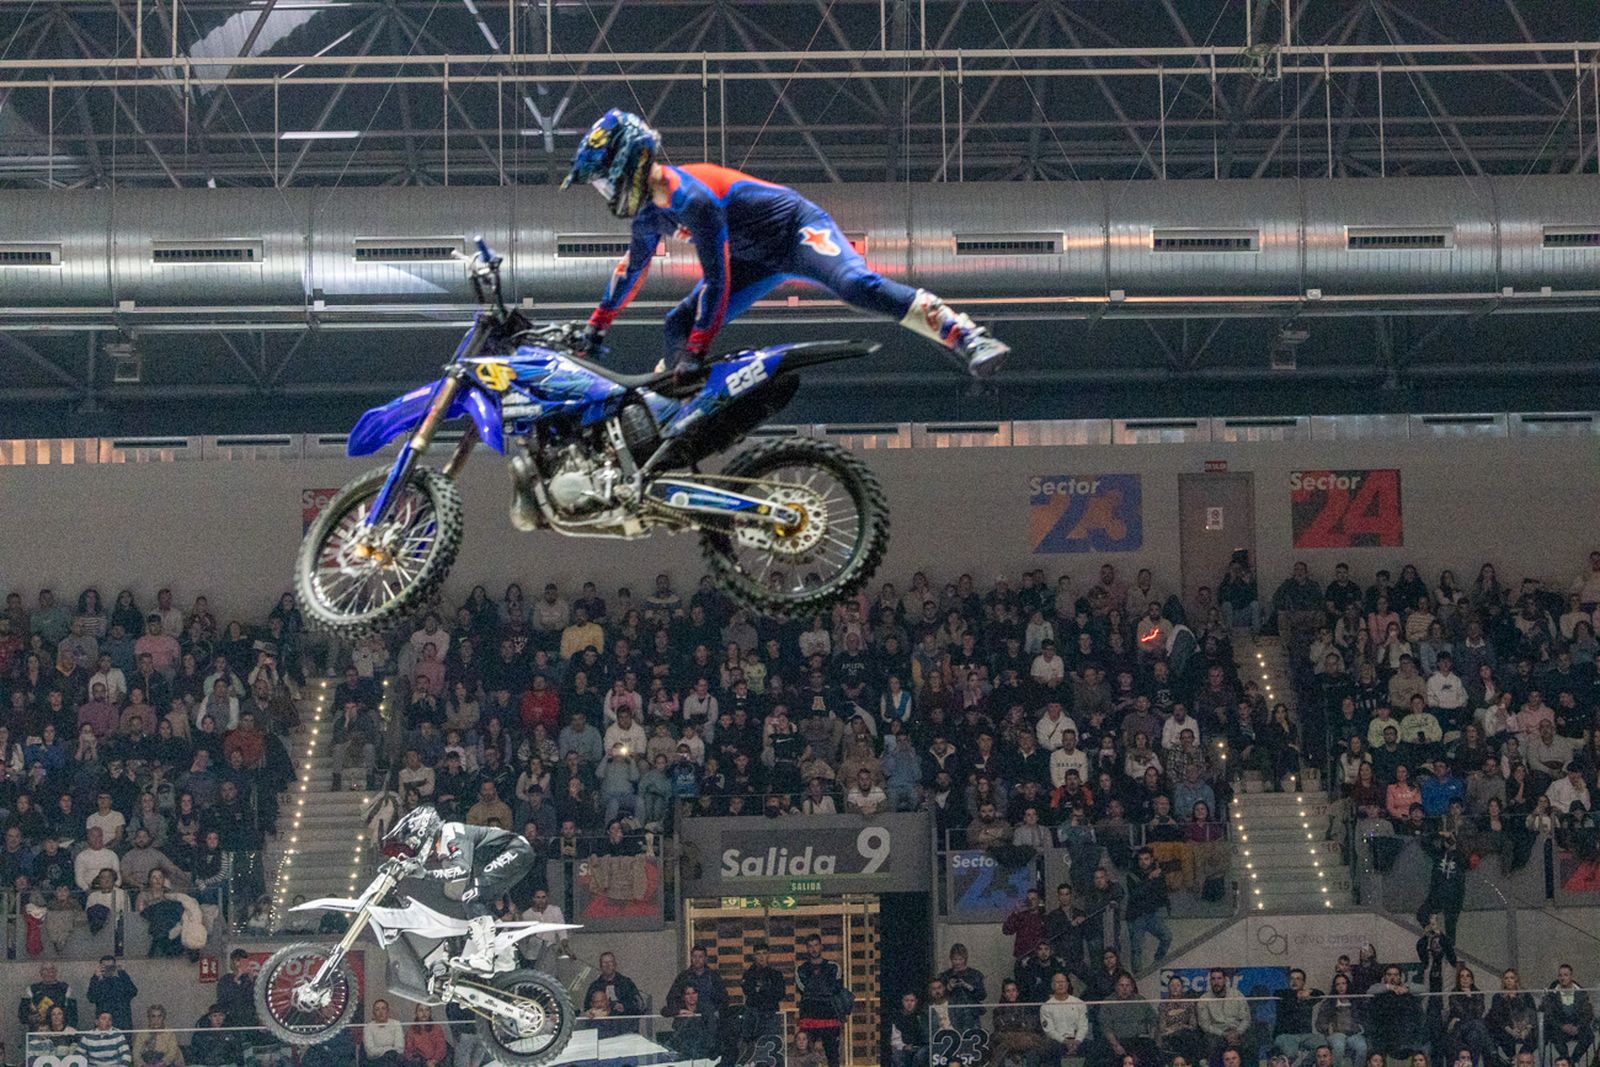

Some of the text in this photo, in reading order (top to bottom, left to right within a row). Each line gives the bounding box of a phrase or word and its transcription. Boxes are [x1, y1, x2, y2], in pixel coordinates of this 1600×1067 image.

[725, 360, 768, 397] 232
[1029, 477, 1100, 496] Sector
[1289, 472, 1361, 490] Sector
[1030, 473, 1143, 554] 23
[1291, 469, 1403, 548] 24
[721, 826, 891, 877] Salida 9
[952, 855, 998, 868] Secto
[791, 882, 822, 891] SALIDA
[932, 1054, 976, 1066] Seor
